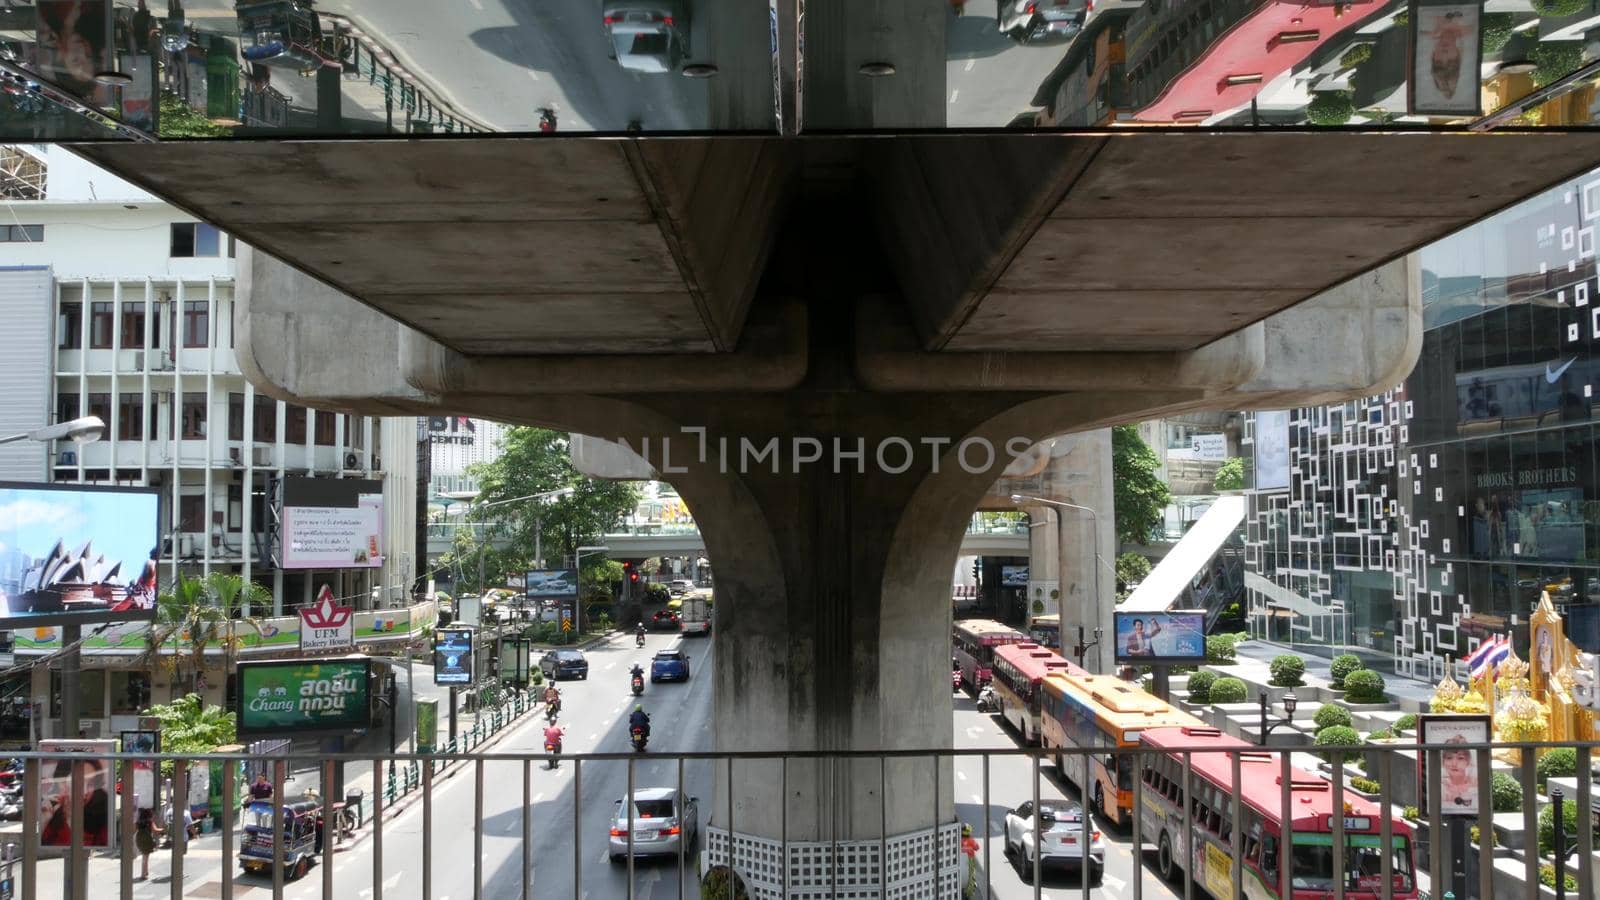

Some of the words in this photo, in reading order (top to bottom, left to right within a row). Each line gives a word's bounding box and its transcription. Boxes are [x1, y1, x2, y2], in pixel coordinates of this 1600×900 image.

[1477, 472, 1513, 488] BROOKS
[1519, 466, 1577, 485] BROTHERS
[314, 628, 339, 639] UFM
[302, 639, 328, 649] Bakery
[329, 638, 350, 646] House
[249, 697, 295, 713] Chang
